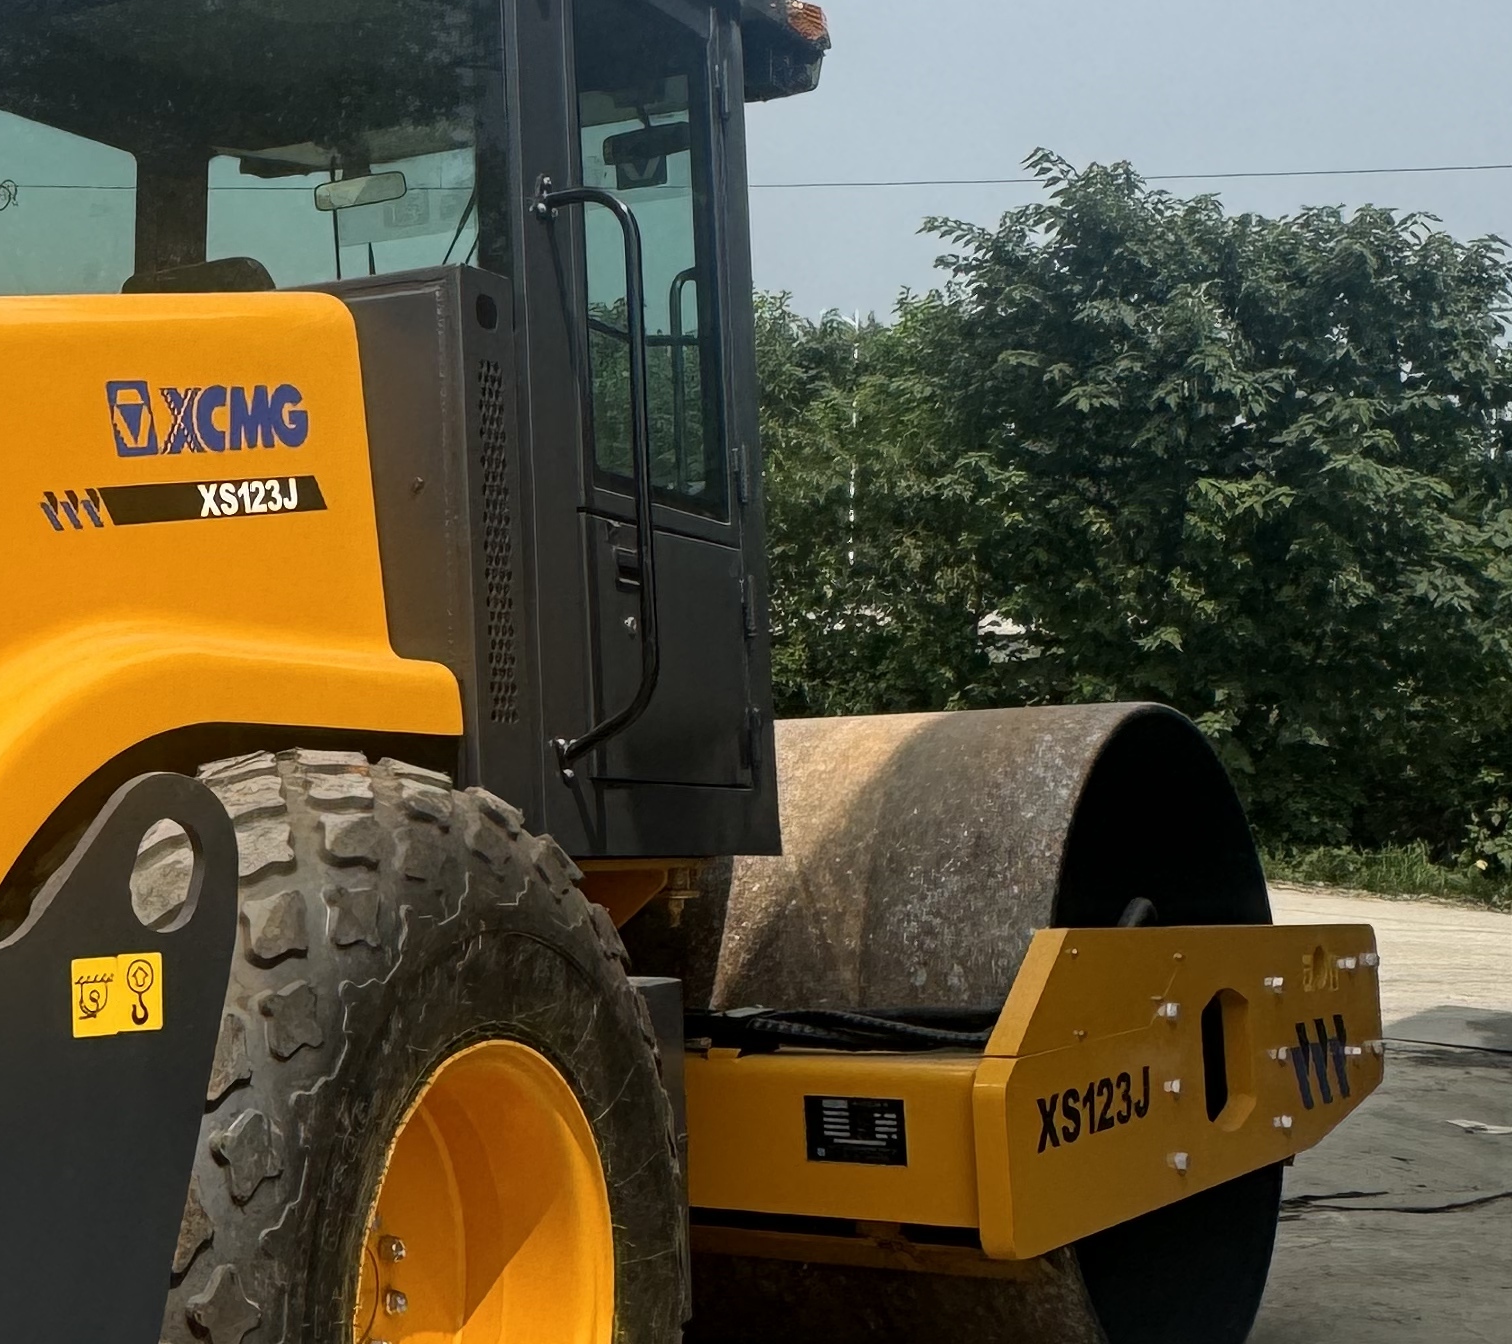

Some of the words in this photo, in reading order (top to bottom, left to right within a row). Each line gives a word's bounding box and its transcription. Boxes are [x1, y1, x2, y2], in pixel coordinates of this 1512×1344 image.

[158, 383, 309, 455] XCMG
[196, 477, 298, 518] XS123J
[1035, 1065, 1151, 1155] XS123J
